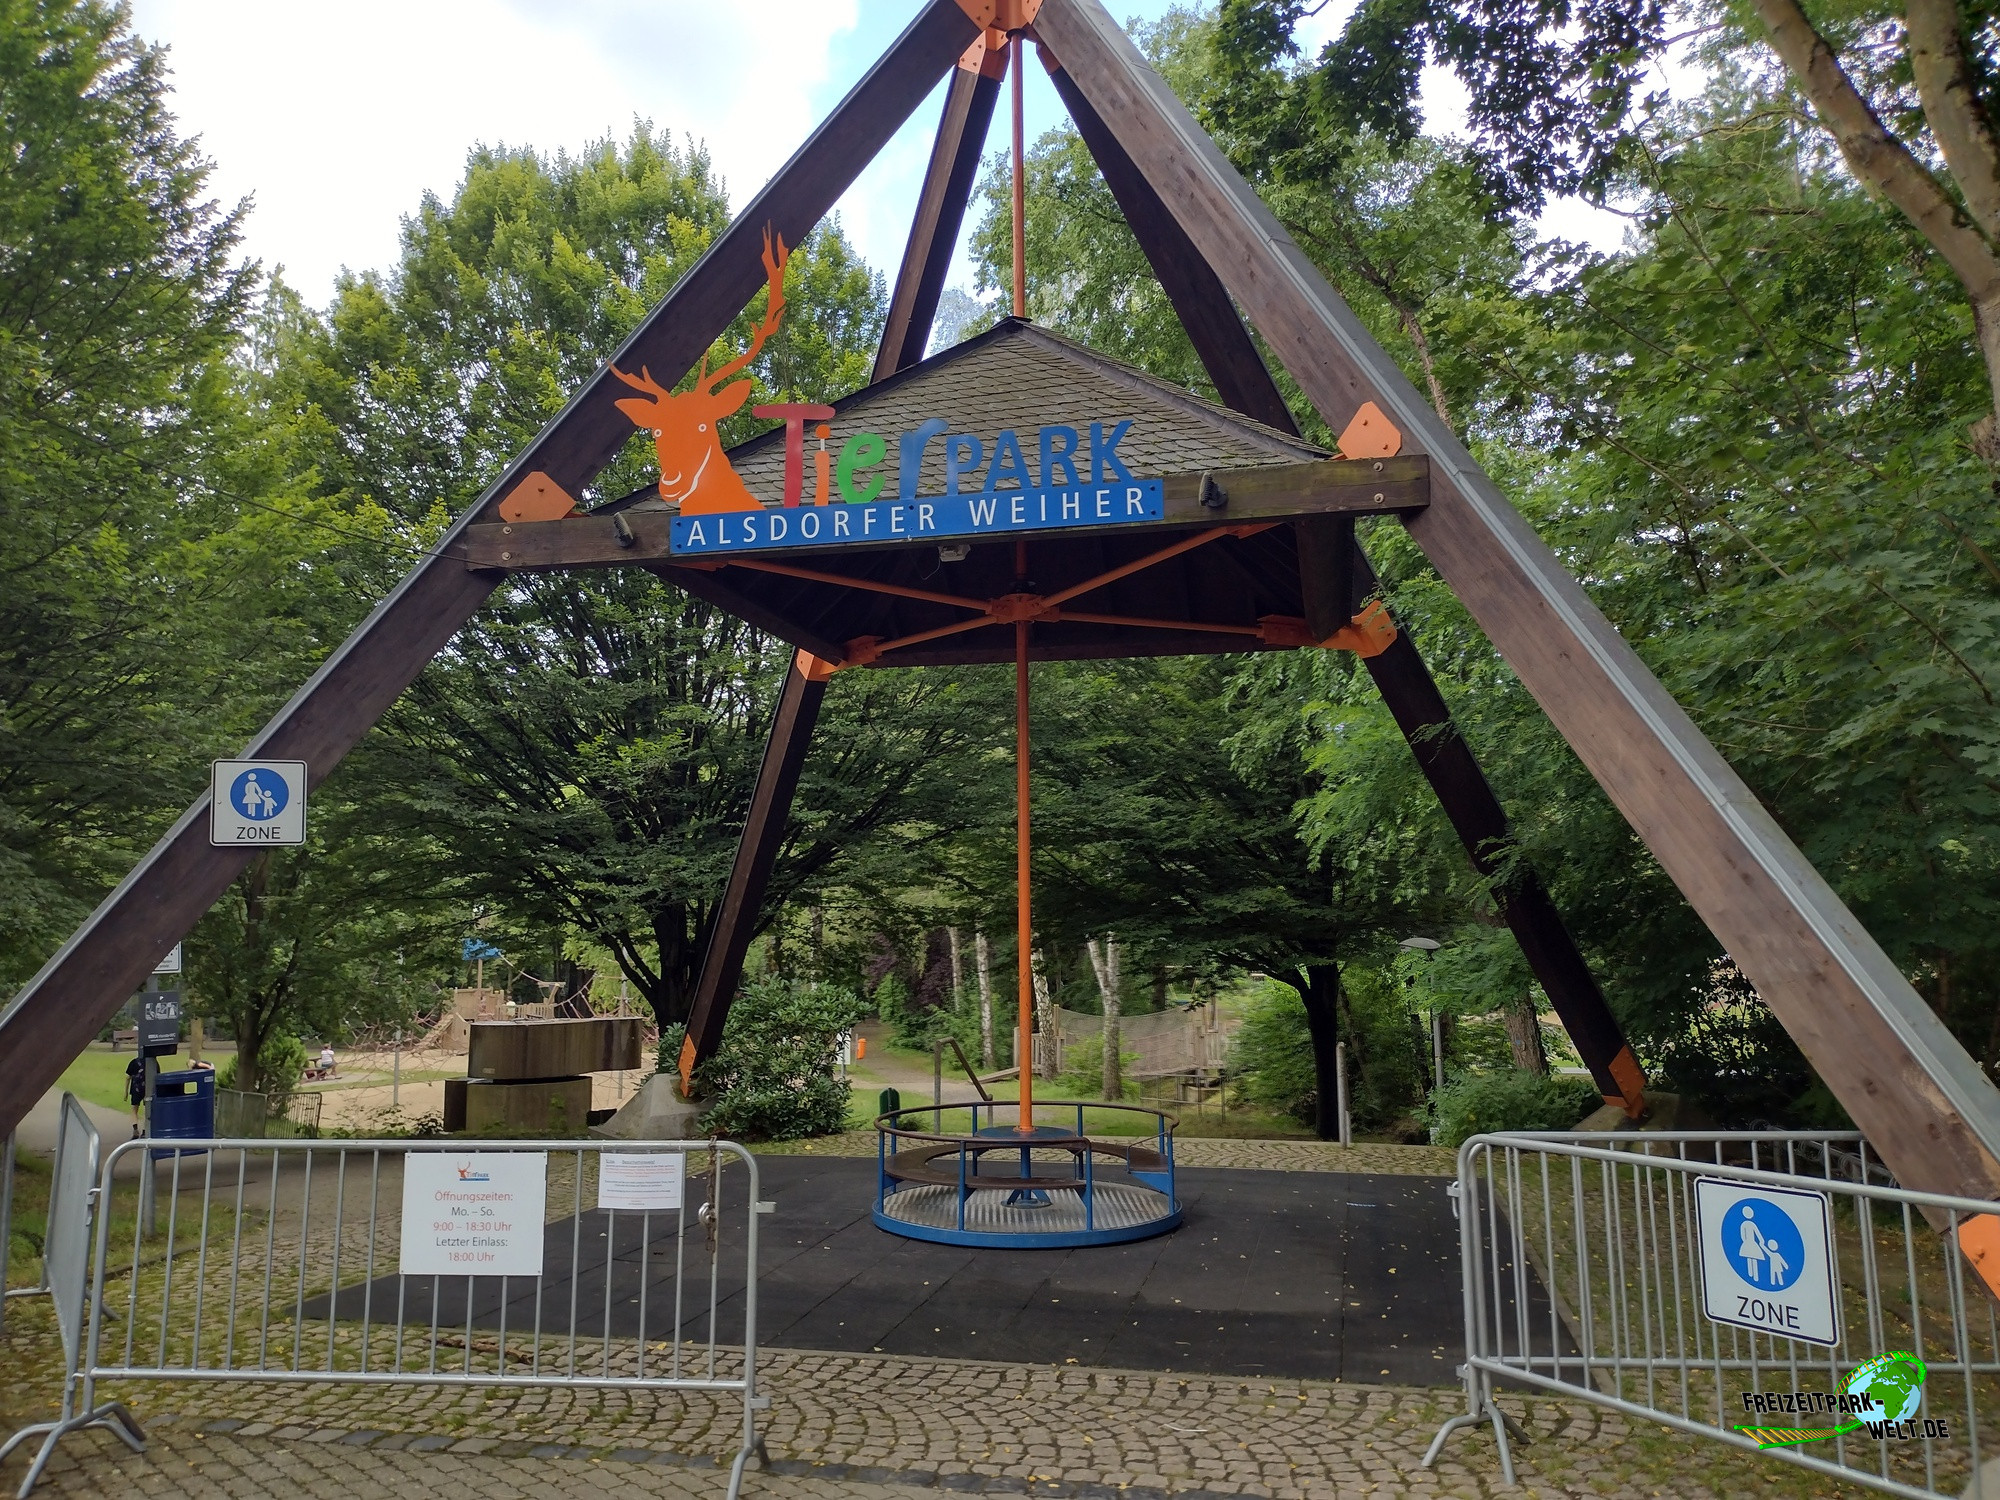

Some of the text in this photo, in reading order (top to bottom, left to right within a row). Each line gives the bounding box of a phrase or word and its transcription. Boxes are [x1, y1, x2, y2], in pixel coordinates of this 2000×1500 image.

[687, 487, 1145, 547] ALSDORFER WEIHER
[236, 826, 281, 840] ZONE
[434, 1190, 514, 1203] Öffnungszeiten:
[451, 1206, 470, 1216] Mo.
[480, 1206, 495, 1216] So.
[433, 1221, 454, 1231] 9:00
[465, 1221, 492, 1231] 18:30
[494, 1221, 512, 1231] Uhr
[436, 1236, 508, 1247] Letzter Einlass:
[448, 1252, 495, 1262] 18:00 Uhr
[1736, 1295, 1801, 1330] ZONE
